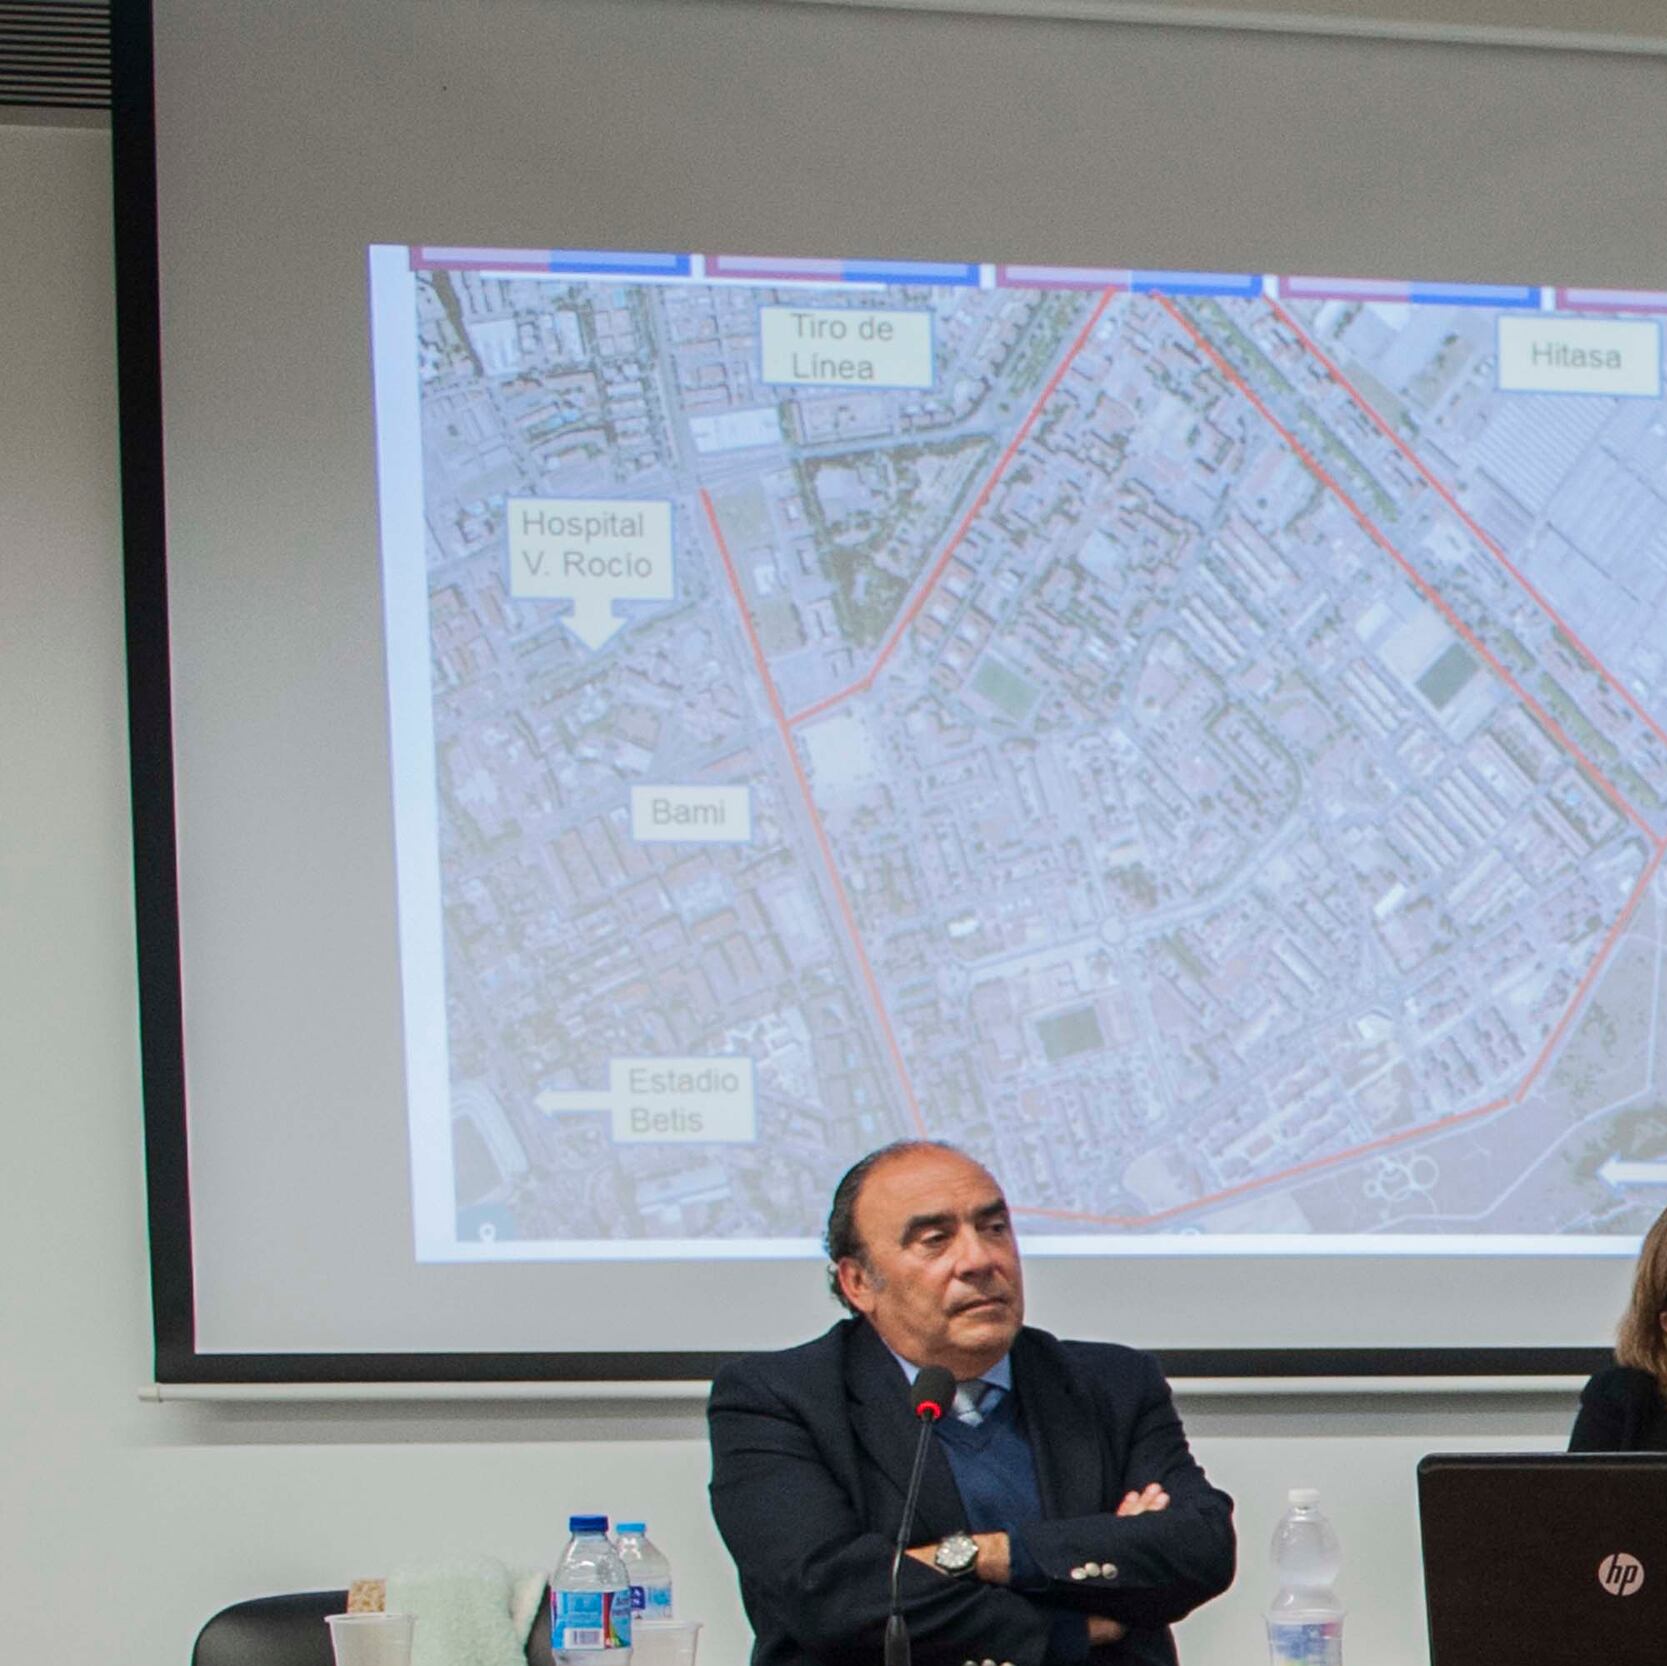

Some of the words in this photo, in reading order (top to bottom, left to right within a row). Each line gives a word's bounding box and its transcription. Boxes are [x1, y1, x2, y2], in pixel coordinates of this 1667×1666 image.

[790, 312, 847, 339] Tiro
[858, 315, 894, 342] de
[1530, 341, 1622, 369] Hitasa
[522, 510, 644, 543] Hospital
[521, 550, 550, 577] V.
[652, 798, 726, 825] Bami
[628, 1067, 740, 1094] Estadio
[629, 1106, 704, 1133] Betis
[1604, 1552, 1639, 1597] hp
